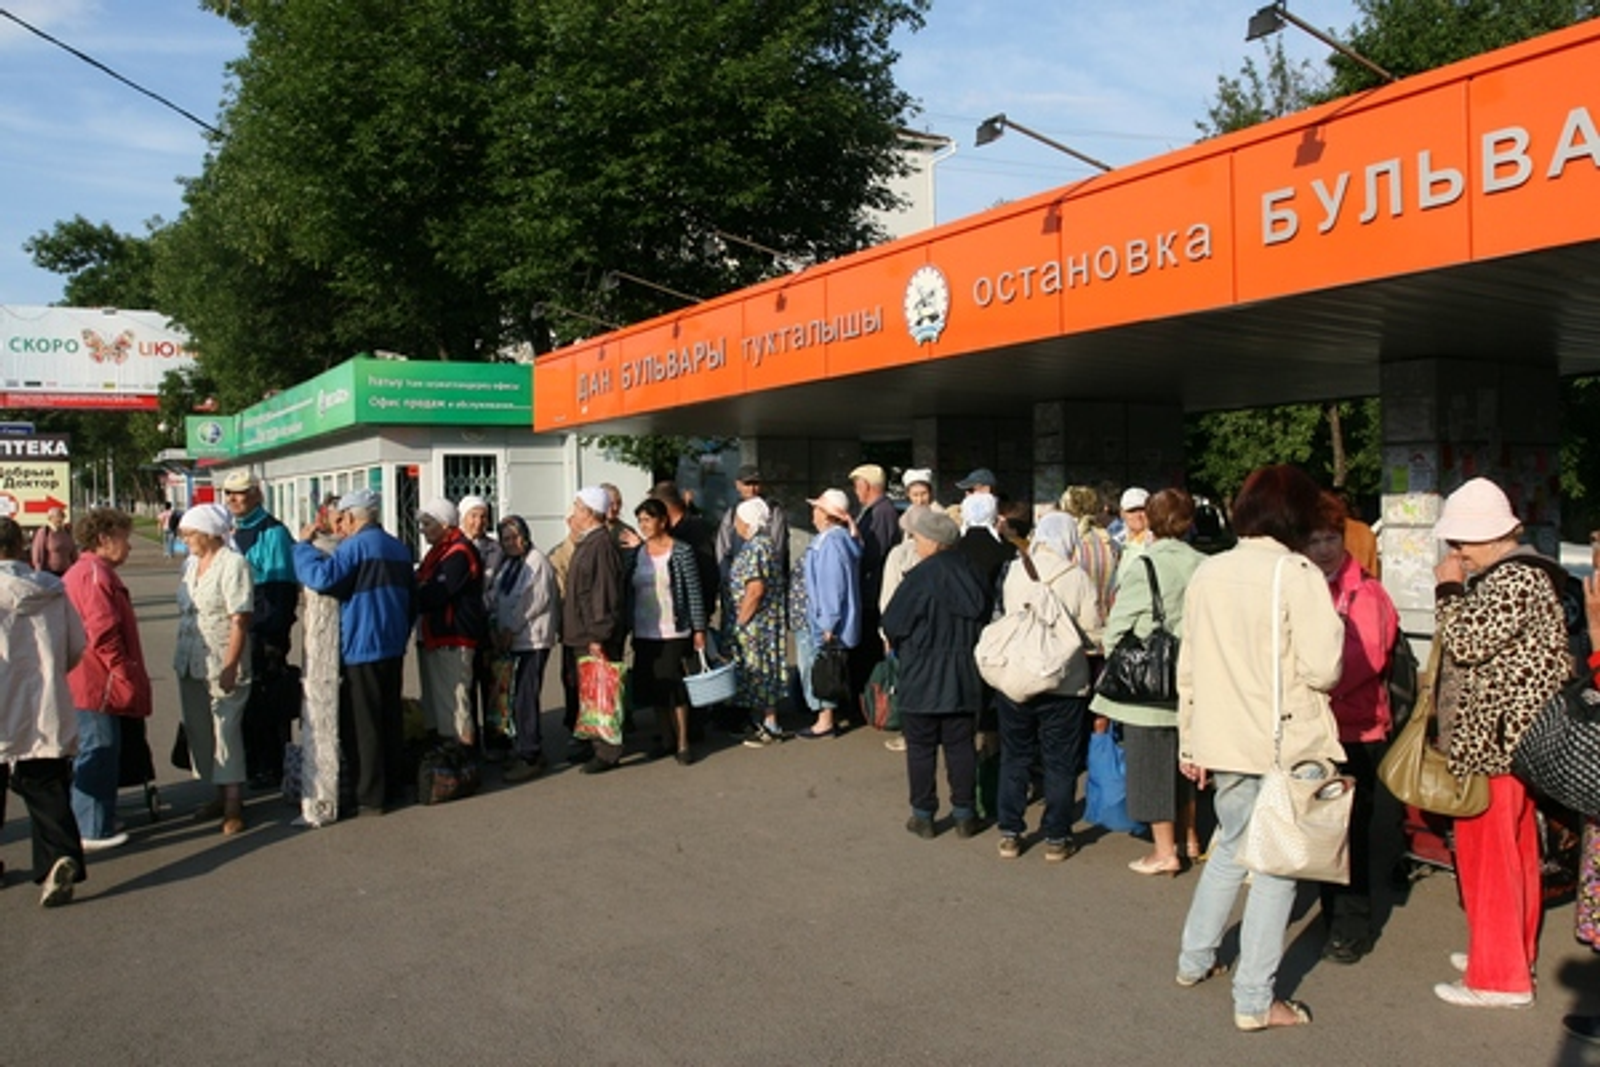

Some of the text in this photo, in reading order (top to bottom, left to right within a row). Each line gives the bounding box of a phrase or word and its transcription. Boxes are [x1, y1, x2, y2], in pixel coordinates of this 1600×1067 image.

[972, 106, 1600, 308] остановка БУЛЬВА
[9, 337, 79, 354] СКОРО
[577, 366, 613, 403] ДАН
[621, 337, 727, 391] БУЛЬВАРЫ
[0, 440, 69, 456] ПТЕКА
[3, 476, 60, 491] Доктор
